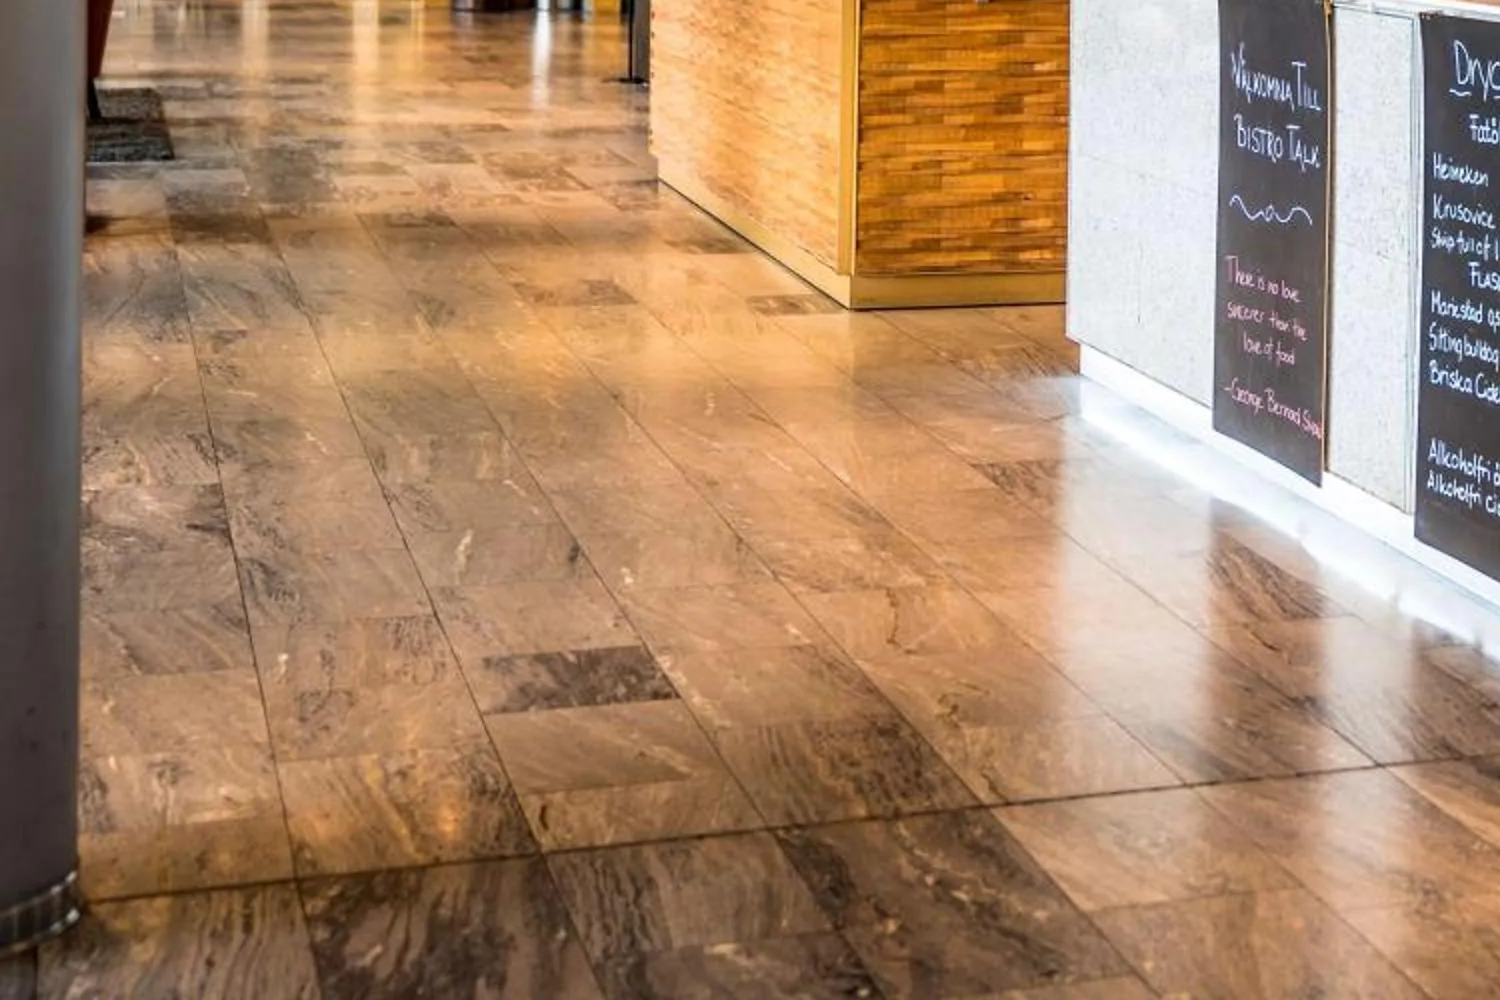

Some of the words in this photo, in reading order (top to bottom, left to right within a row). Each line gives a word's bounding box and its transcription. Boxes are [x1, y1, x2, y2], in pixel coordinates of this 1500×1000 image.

[1433, 152, 1489, 187] Heineken
[1433, 193, 1496, 229] Krusovice
[1281, 279, 1301, 303] love
[1431, 290, 1483, 325] Mariestad
[1243, 331, 1262, 355] love
[1264, 336, 1274, 360] of
[1275, 340, 1295, 367] food
[1429, 359, 1472, 394] Briska
[1429, 437, 1491, 484] Alkoholfri
[1427, 469, 1482, 510] Alkoholfri
